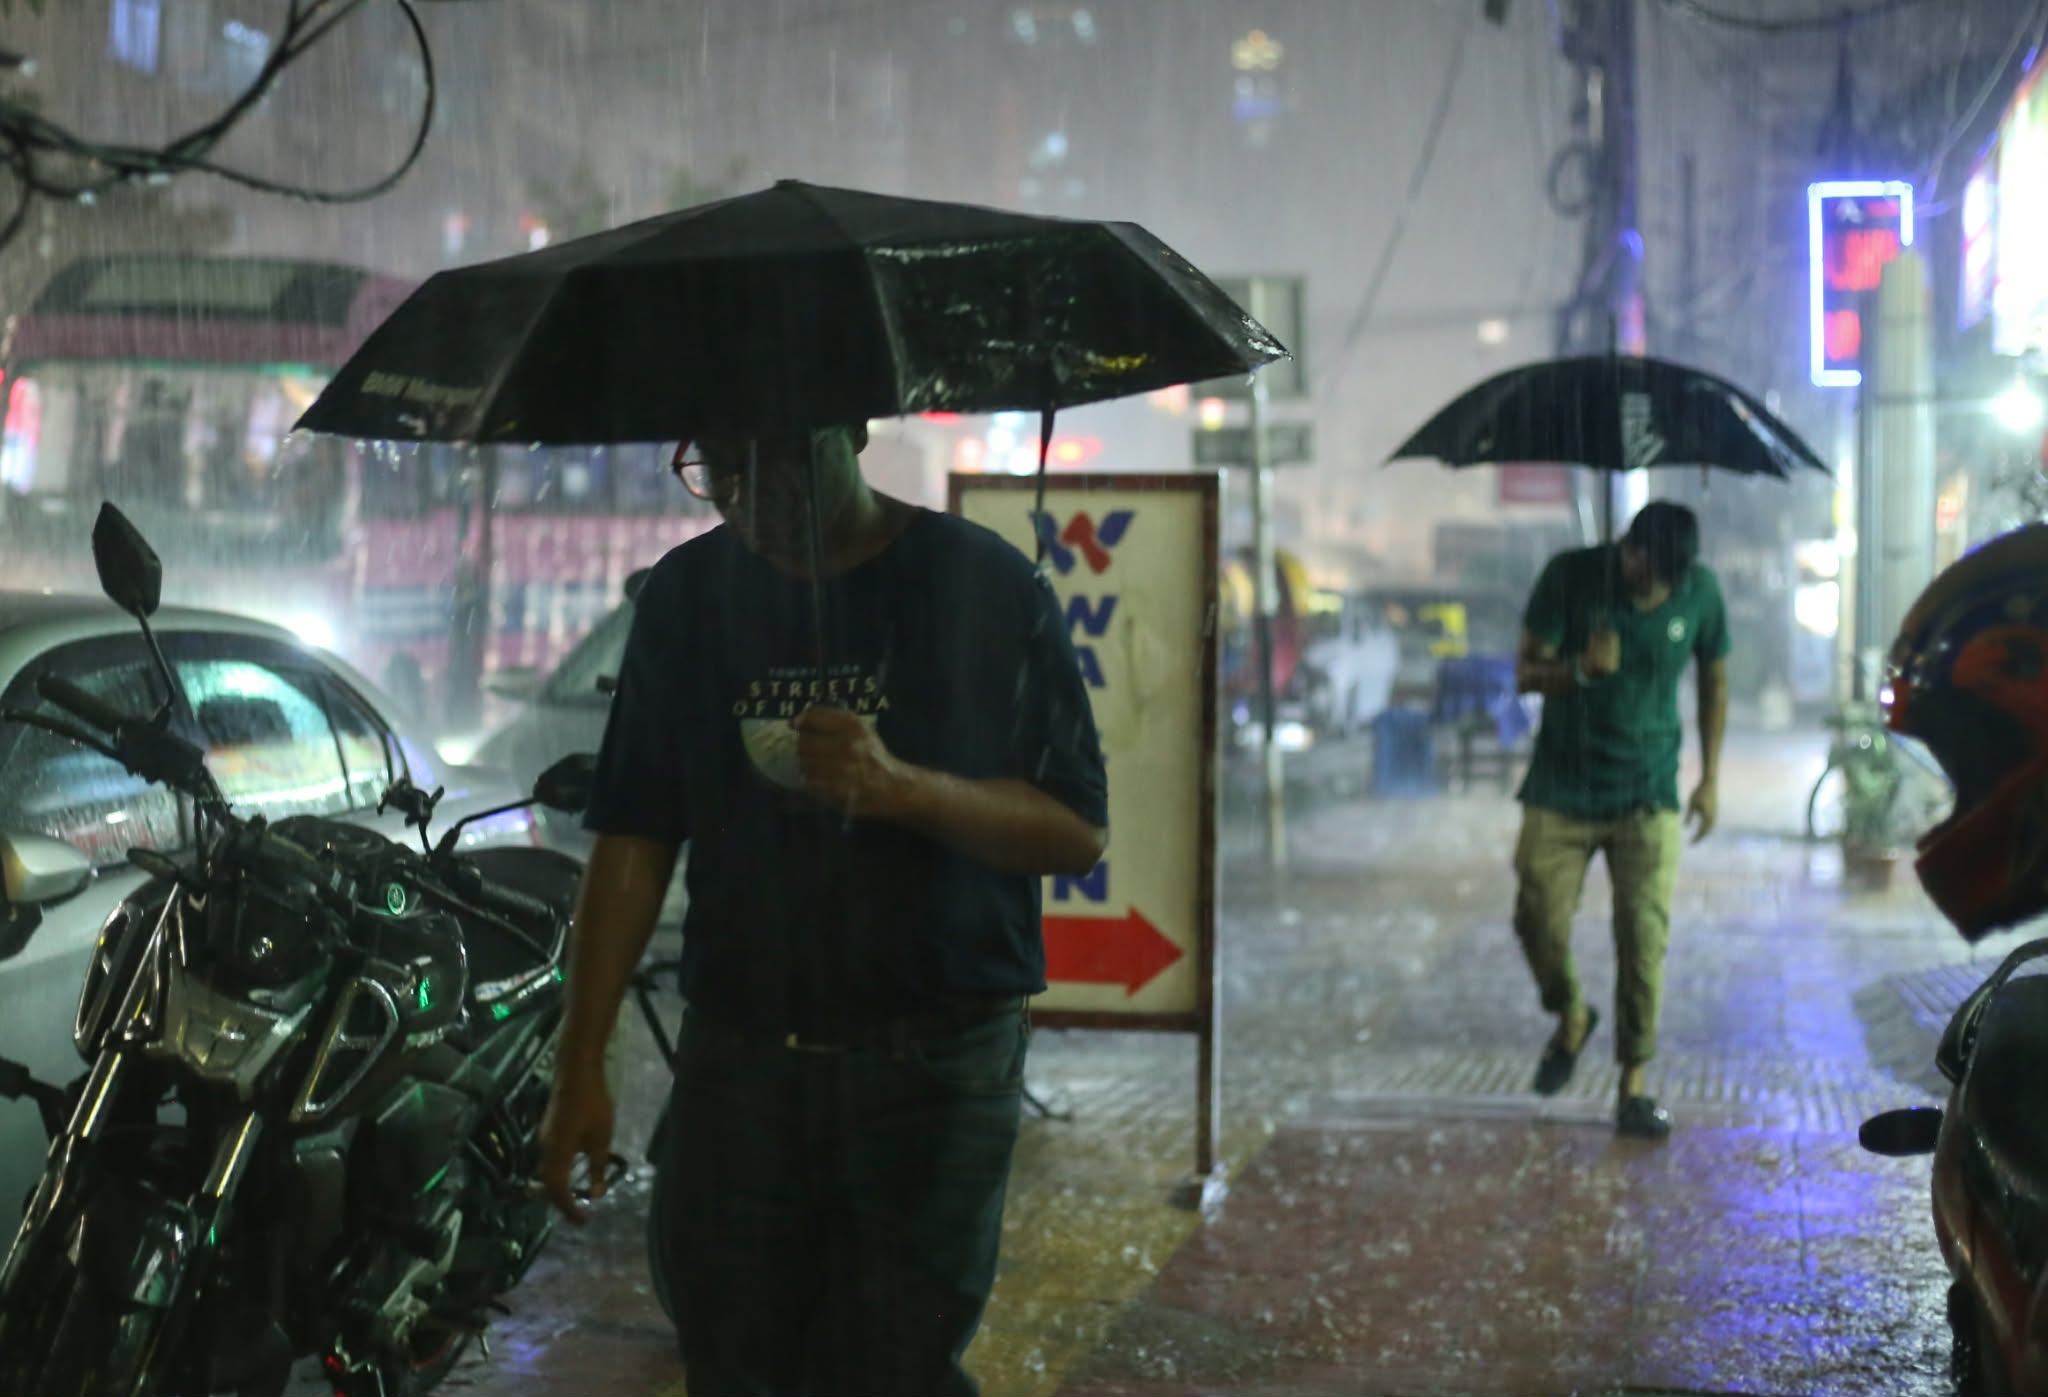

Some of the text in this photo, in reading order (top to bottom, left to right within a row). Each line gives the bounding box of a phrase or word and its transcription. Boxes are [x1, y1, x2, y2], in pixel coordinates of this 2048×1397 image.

[749, 676, 878, 697] STREETS
[732, 695, 890, 717] OF HNA
